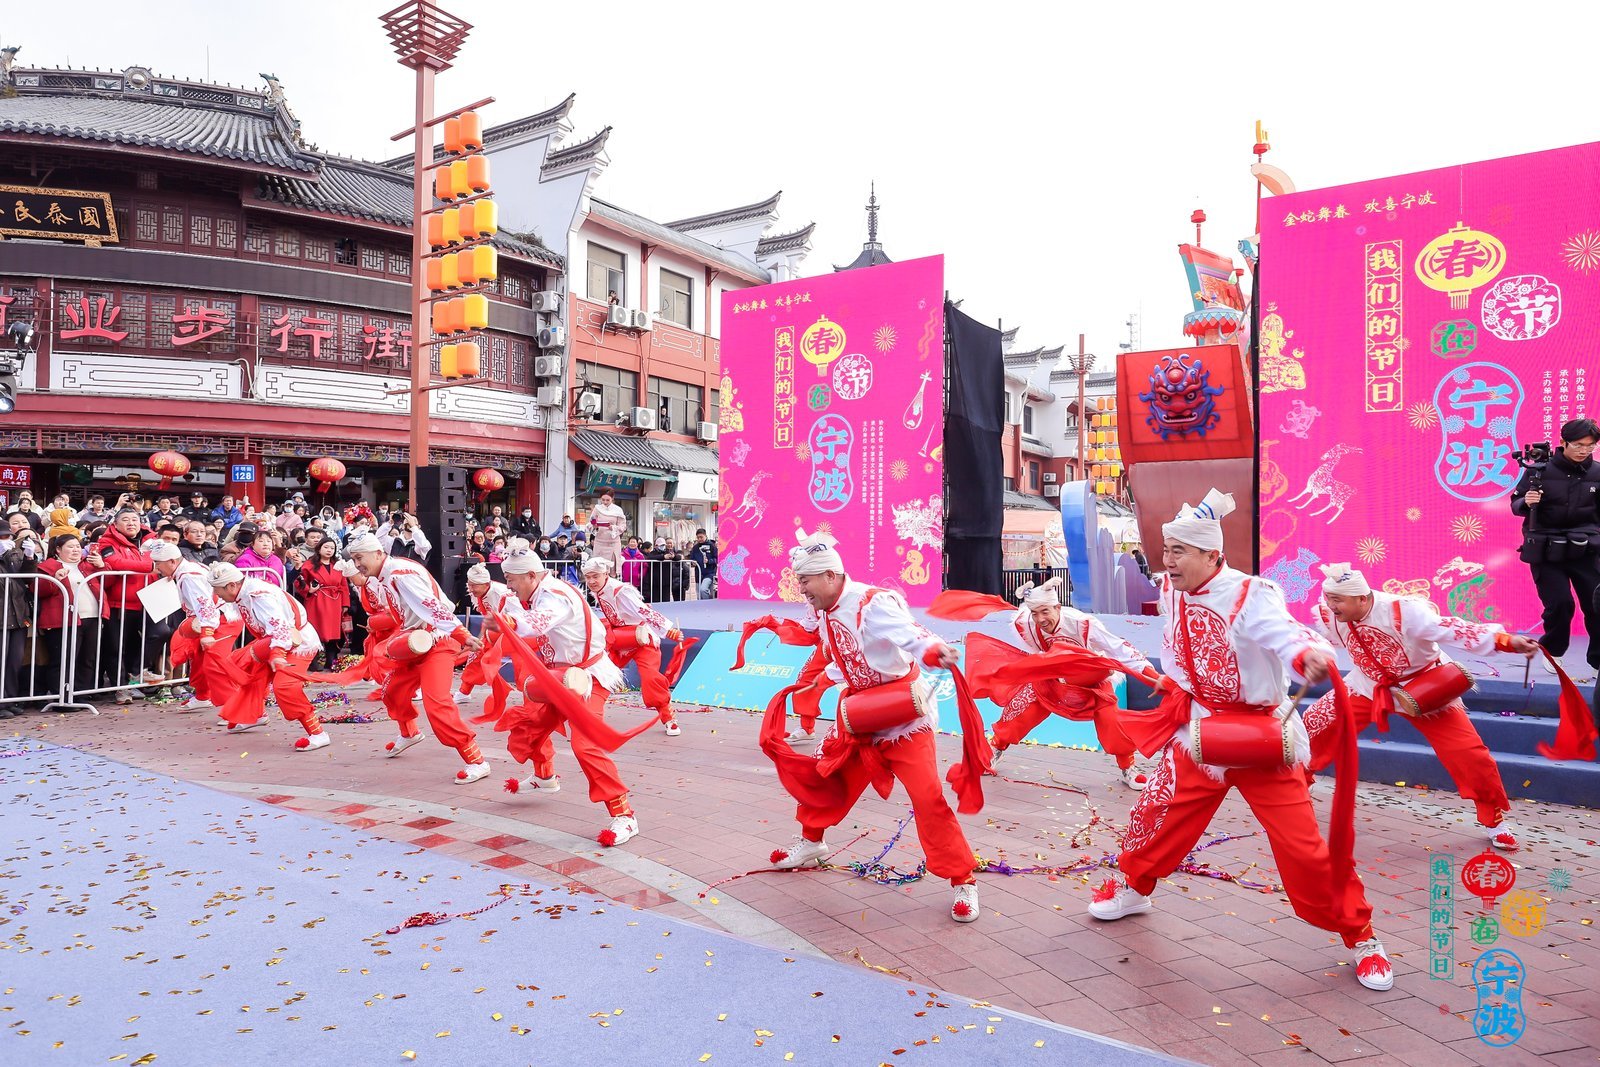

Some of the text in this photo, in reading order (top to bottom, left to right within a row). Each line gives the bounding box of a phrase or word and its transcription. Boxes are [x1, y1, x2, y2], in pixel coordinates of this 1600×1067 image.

[1283, 190, 1437, 227] 金蛇舞春 欢喜宁波
[1432, 239, 1489, 280] 春
[733, 291, 812, 314] 金蛇舞春 欢喜宁波
[1508, 295, 1558, 331] 节
[0, 296, 412, 367] 业步行街
[809, 327, 836, 356] 春
[1368, 248, 1398, 404] 我们的节日
[1439, 325, 1478, 353] 在
[776, 331, 792, 443] 我们的节日
[811, 385, 831, 410] 在
[846, 367, 870, 395] 节
[1542, 370, 1553, 403] 主办单位
[1559, 369, 1570, 402] 承办单位
[1575, 367, 1586, 401] 协办单位
[1446, 380, 1514, 487] 宁波
[2, 468, 28, 481] 商店
[235, 472, 251, 480] 128
[815, 427, 849, 502] 宁波
